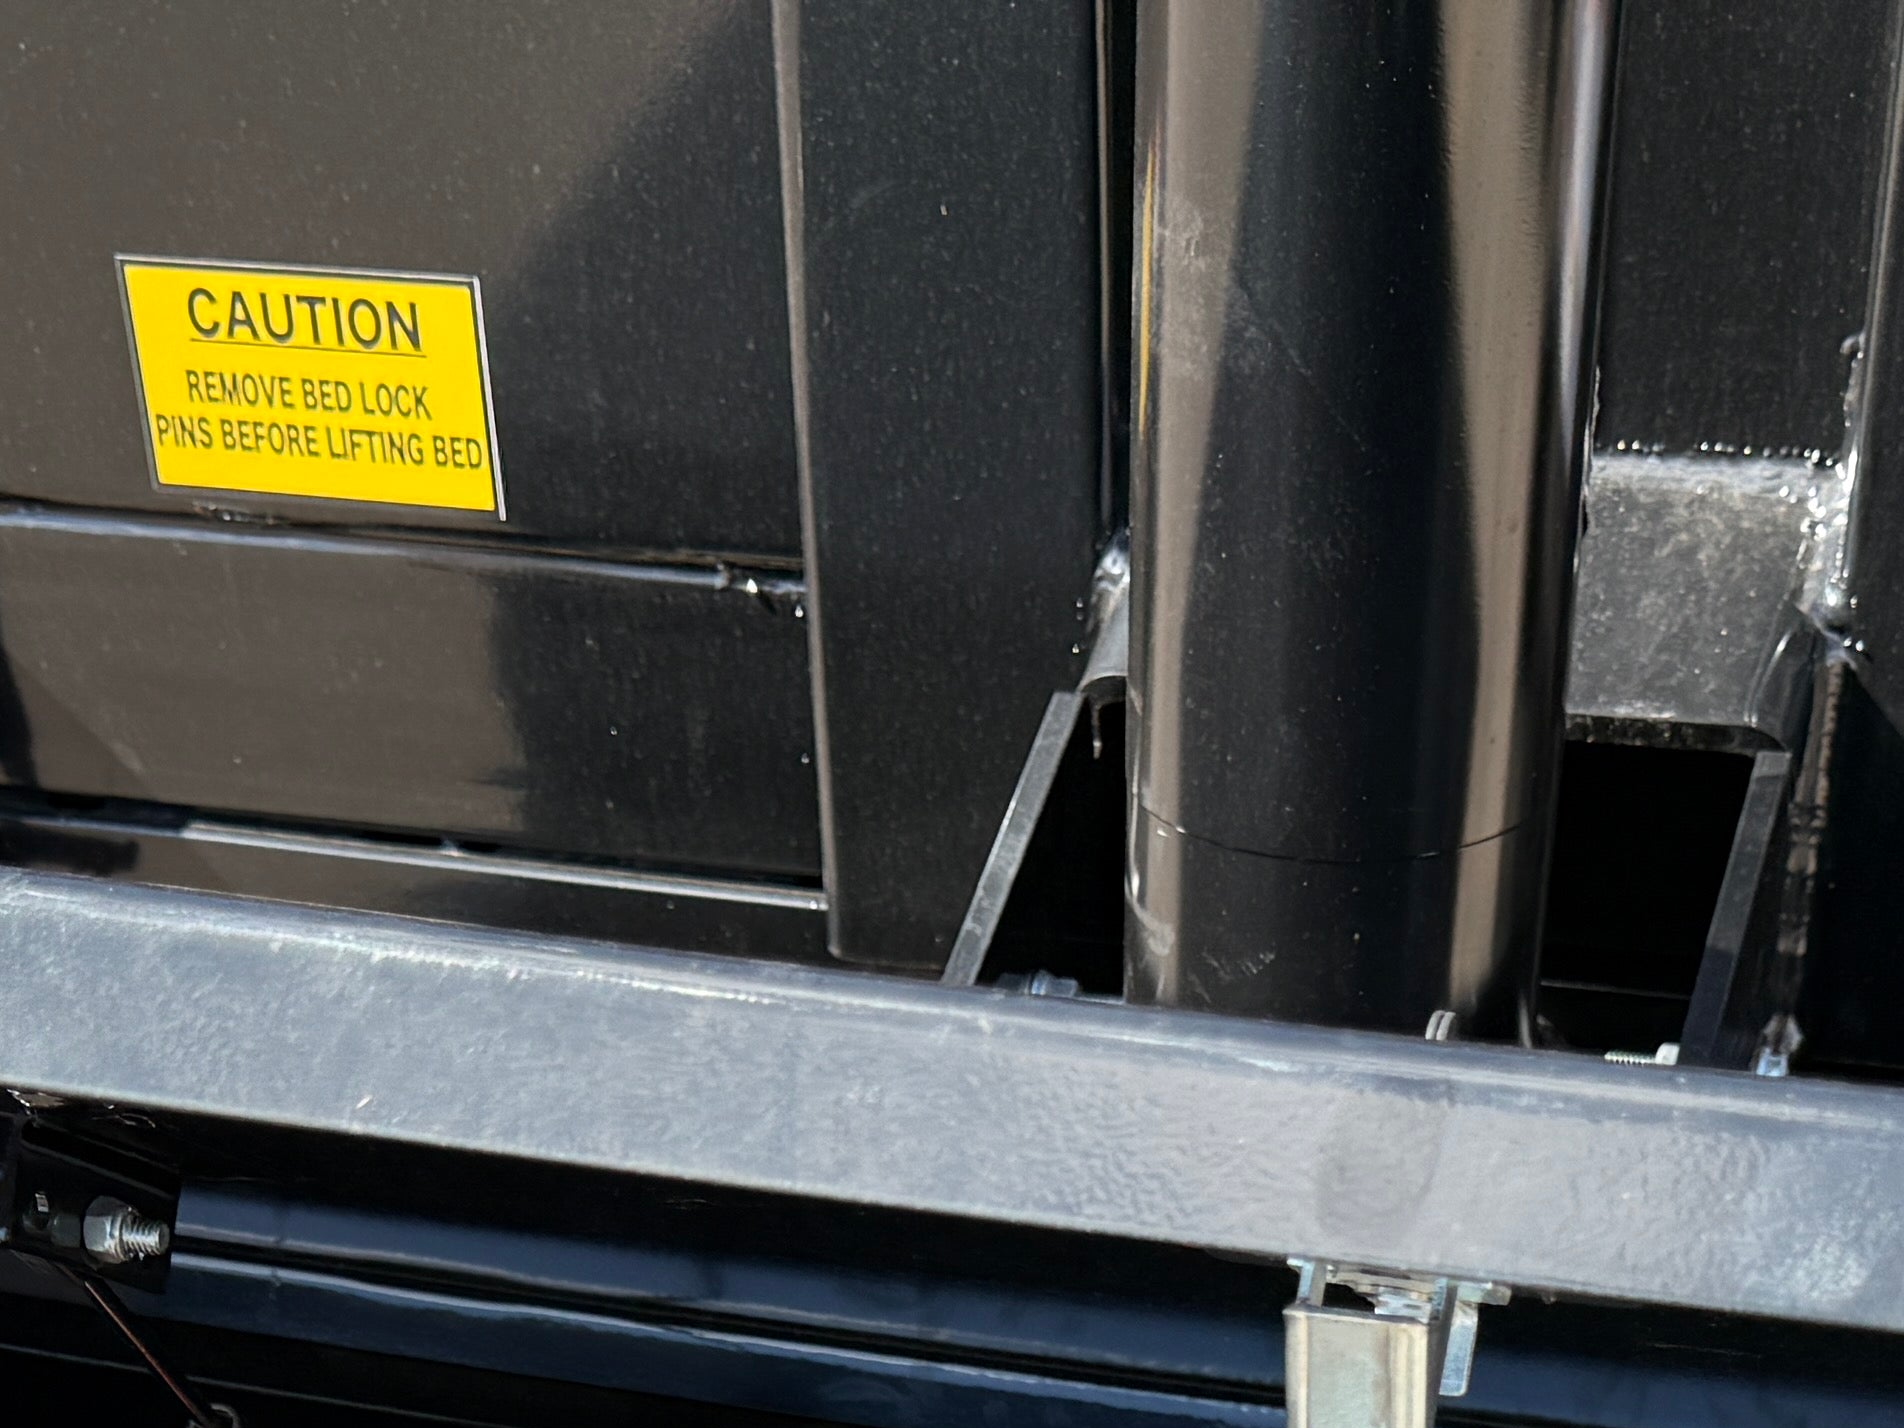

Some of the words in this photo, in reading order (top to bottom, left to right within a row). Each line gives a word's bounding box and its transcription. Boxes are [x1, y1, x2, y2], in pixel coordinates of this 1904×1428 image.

[187, 287, 423, 352] CAUTION
[185, 369, 295, 409] REMOVE
[300, 378, 353, 413] BED
[359, 382, 433, 420] LOCK
[156, 413, 214, 450] PINS
[220, 418, 321, 457] BEFORE
[325, 425, 425, 466] LIFTING
[433, 435, 482, 469] BED
